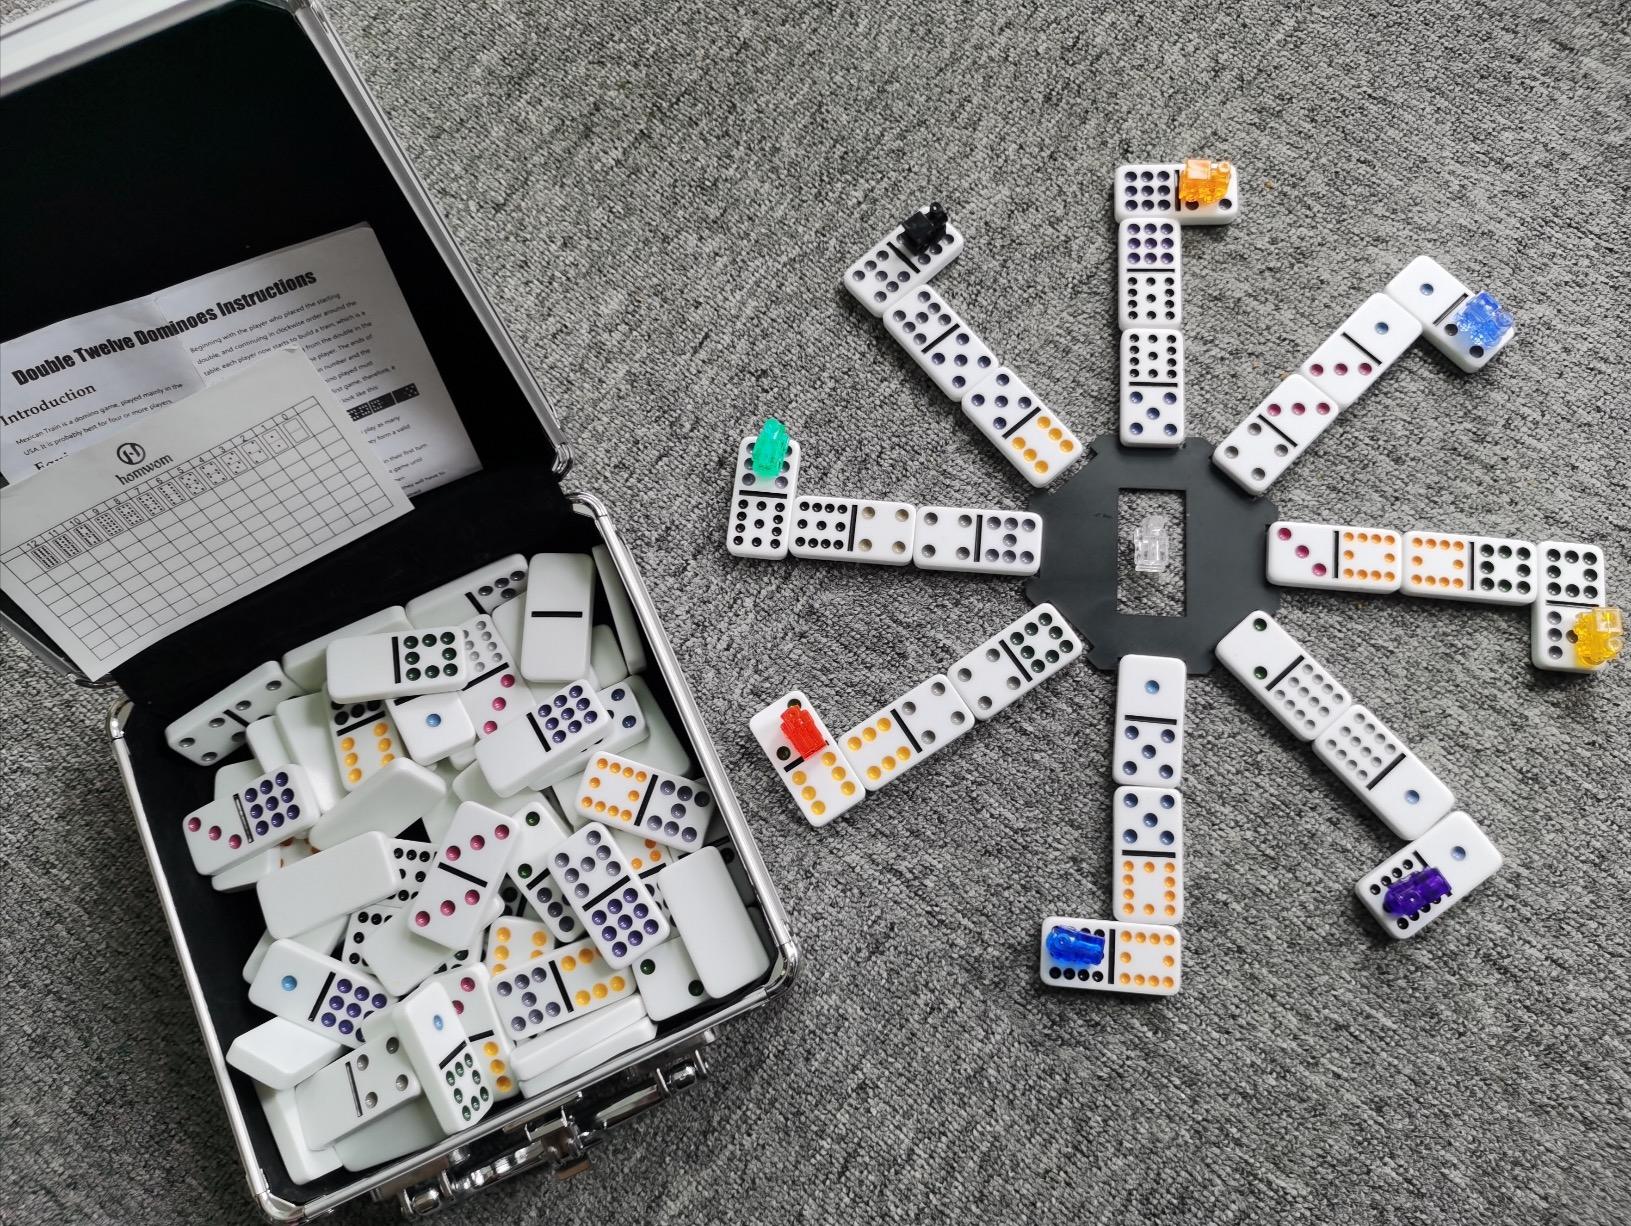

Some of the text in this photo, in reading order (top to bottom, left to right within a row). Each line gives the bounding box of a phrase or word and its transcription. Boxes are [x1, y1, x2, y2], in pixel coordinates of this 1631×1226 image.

[12, 271, 317, 386] Double Twelve Dominoes Instructions
[221, 347, 233, 355] and
[234, 335, 268, 349] continuing
[276, 320, 304, 334] clockwise
[306, 314, 322, 322] order
[223, 332, 236, 340] with
[249, 320, 268, 332] player
[284, 306, 304, 318] placed
[222, 360, 237, 368] each
[238, 353, 256, 363] player
[272, 340, 289, 349] starts
[298, 329, 314, 339] build
[305, 341, 320, 349] from
[0, 386, 96, 426] Introduction
[16, 431, 44, 444] Mexican
[43, 424, 61, 434] Train
[74, 410, 99, 422] domino
[121, 395, 142, 406] played
[143, 388, 163, 398] mainly
[54, 431, 82, 445] probably
[83, 425, 97, 433] best
[131, 407, 149, 415] more
[27, 540, 39, 549] 12
[48, 530, 59, 538] 11
[70, 518, 82, 527] 10
